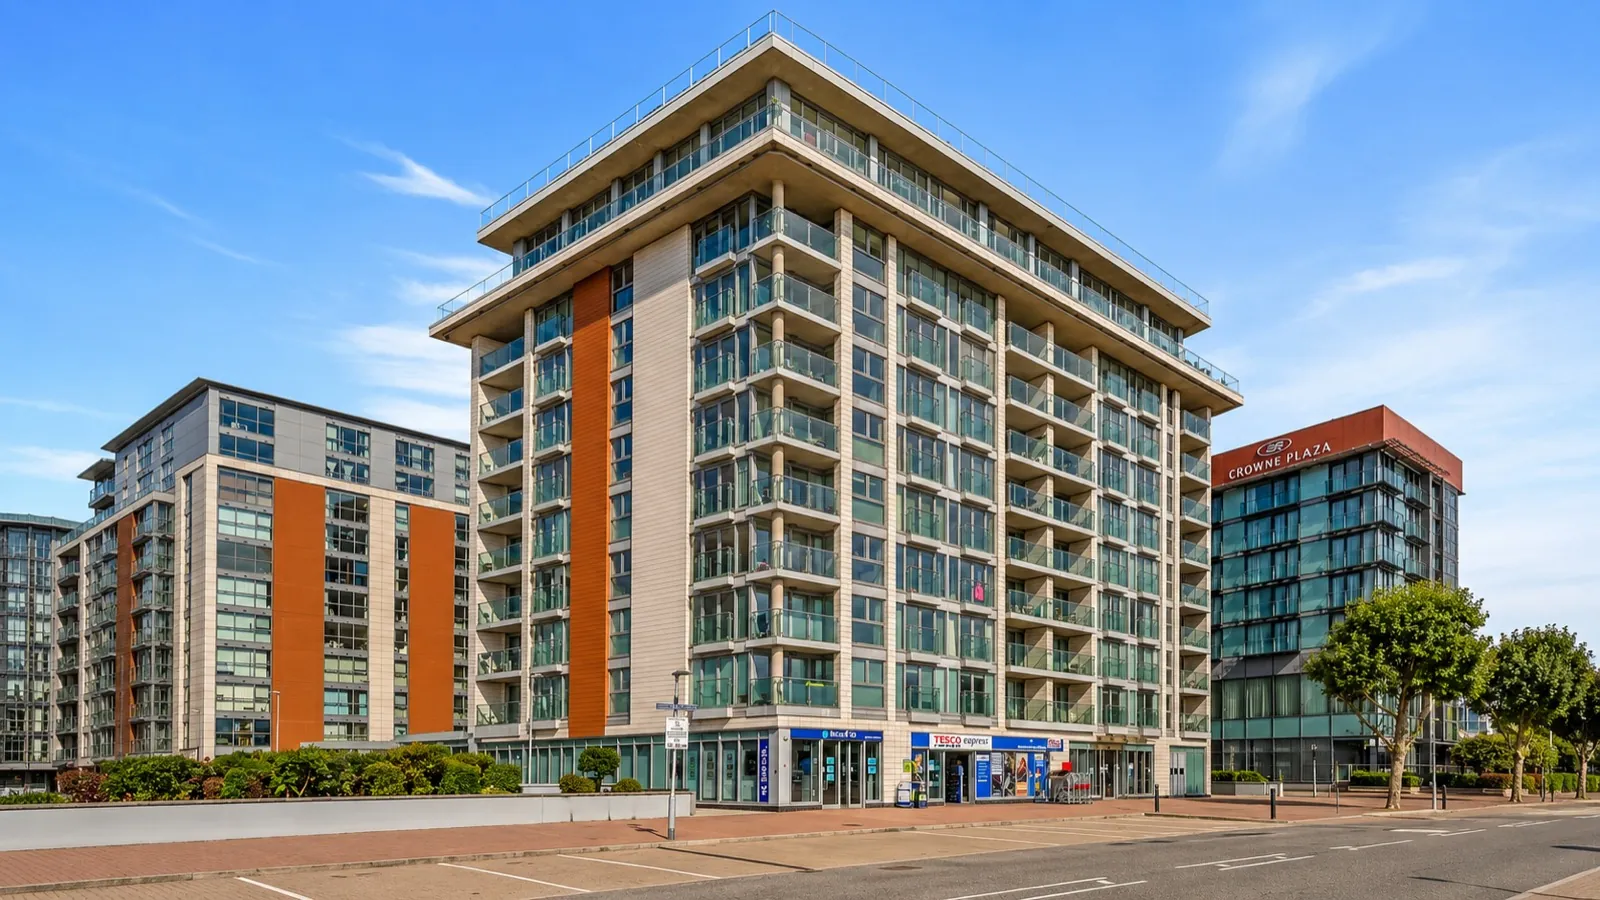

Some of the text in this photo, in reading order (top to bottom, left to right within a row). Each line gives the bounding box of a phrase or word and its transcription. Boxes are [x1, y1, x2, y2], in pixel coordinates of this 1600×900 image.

[1228, 441, 1331, 480] CROWNE PLAZA
[934, 735, 962, 745] TESCO
